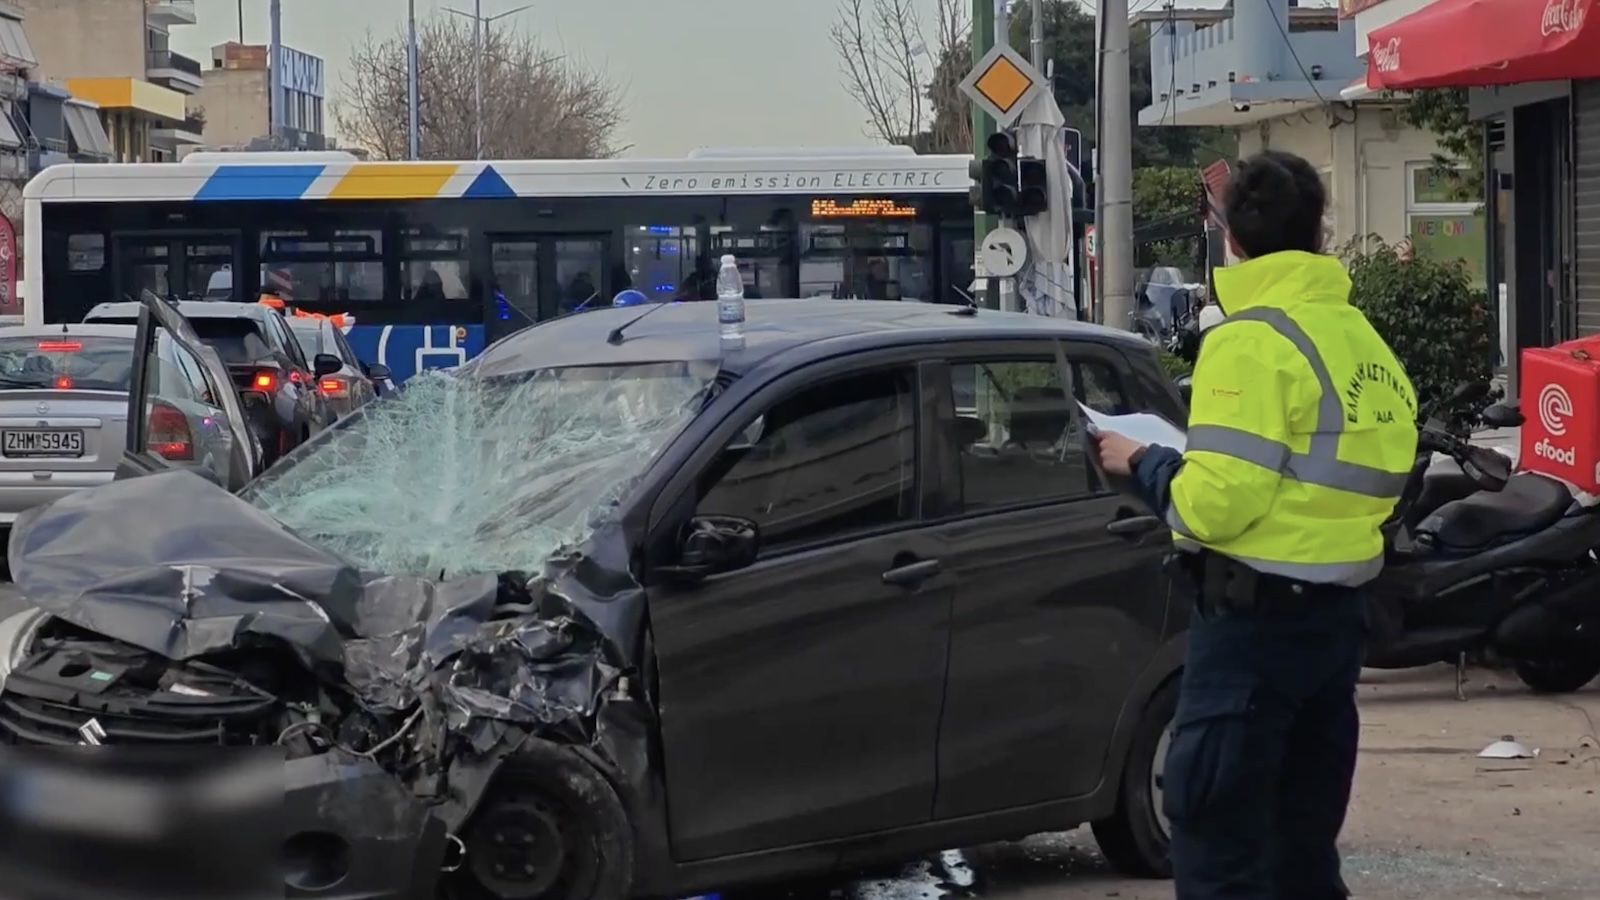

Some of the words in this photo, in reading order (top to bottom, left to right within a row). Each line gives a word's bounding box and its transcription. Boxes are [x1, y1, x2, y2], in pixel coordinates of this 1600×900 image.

[645, 175, 697, 190] Zero
[711, 173, 820, 189] emission
[833, 171, 944, 187] ELECTRIC
[42, 433, 79, 449] 5945
[1534, 437, 1575, 467] efood
